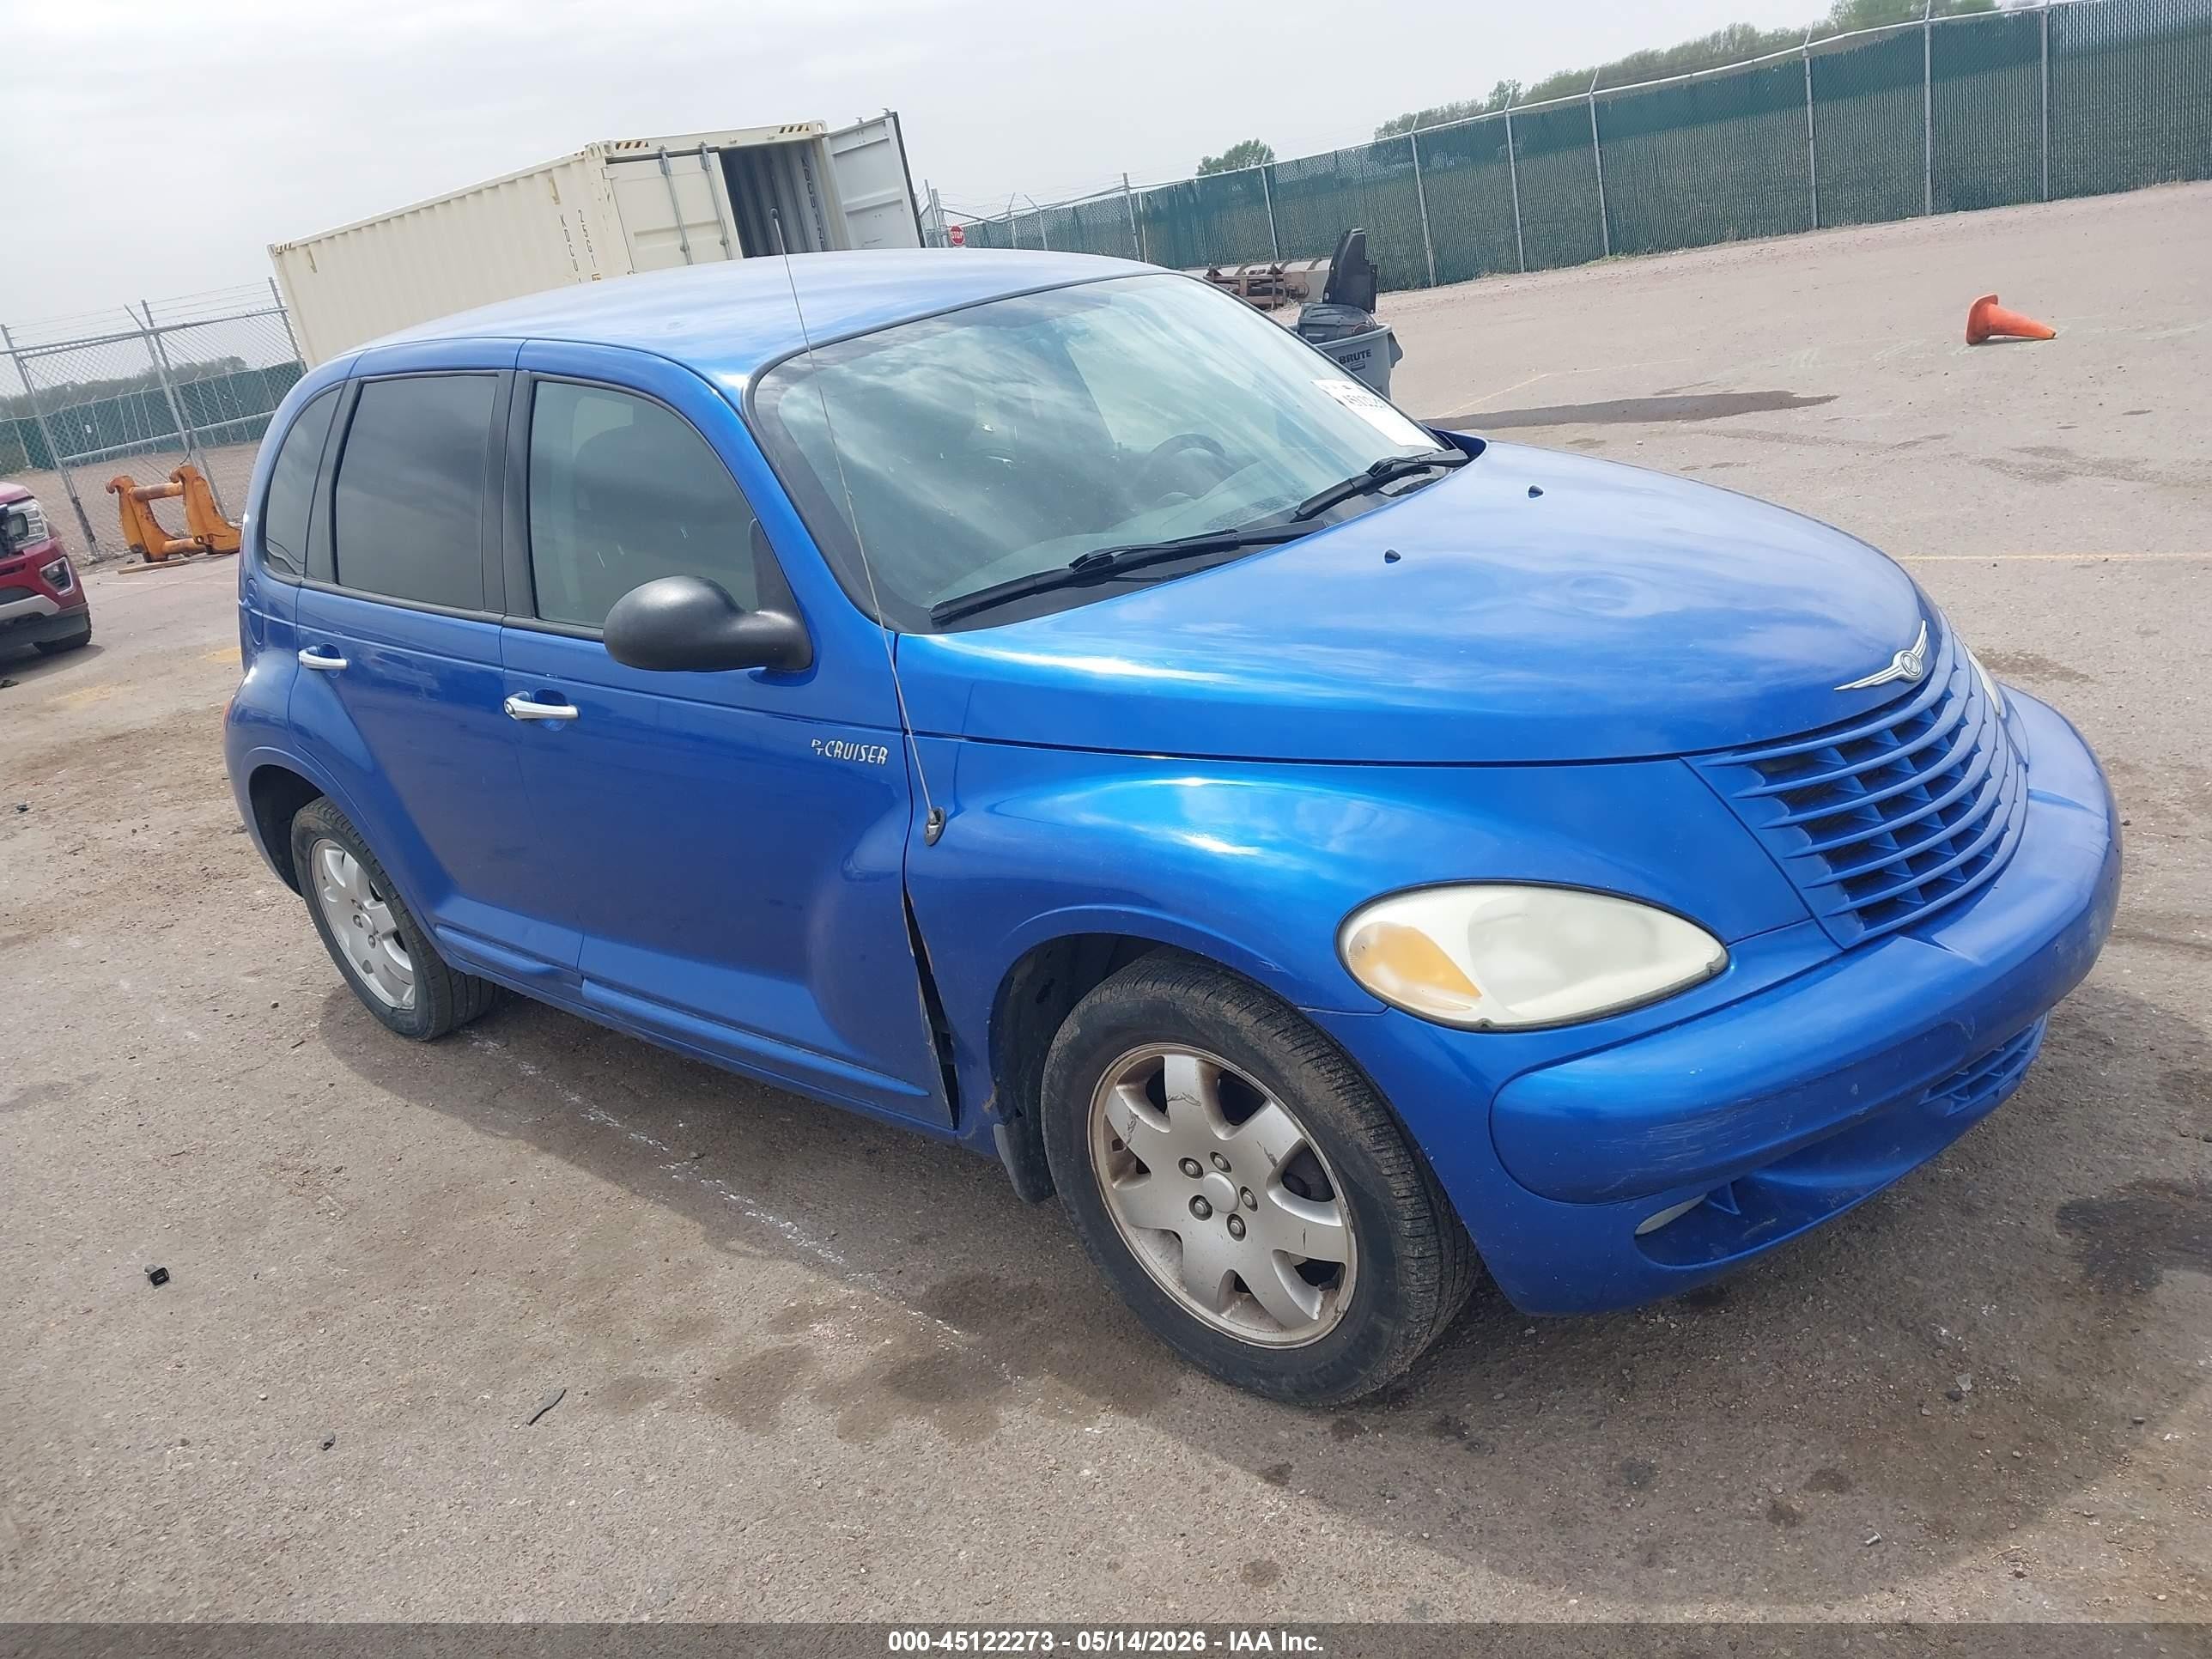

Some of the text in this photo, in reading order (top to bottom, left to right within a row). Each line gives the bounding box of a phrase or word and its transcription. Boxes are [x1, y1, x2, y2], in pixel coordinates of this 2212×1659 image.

[951, 231, 963, 240] STOP
[1338, 349, 1372, 364] BRUTE
[824, 739, 889, 765] CRUISER
